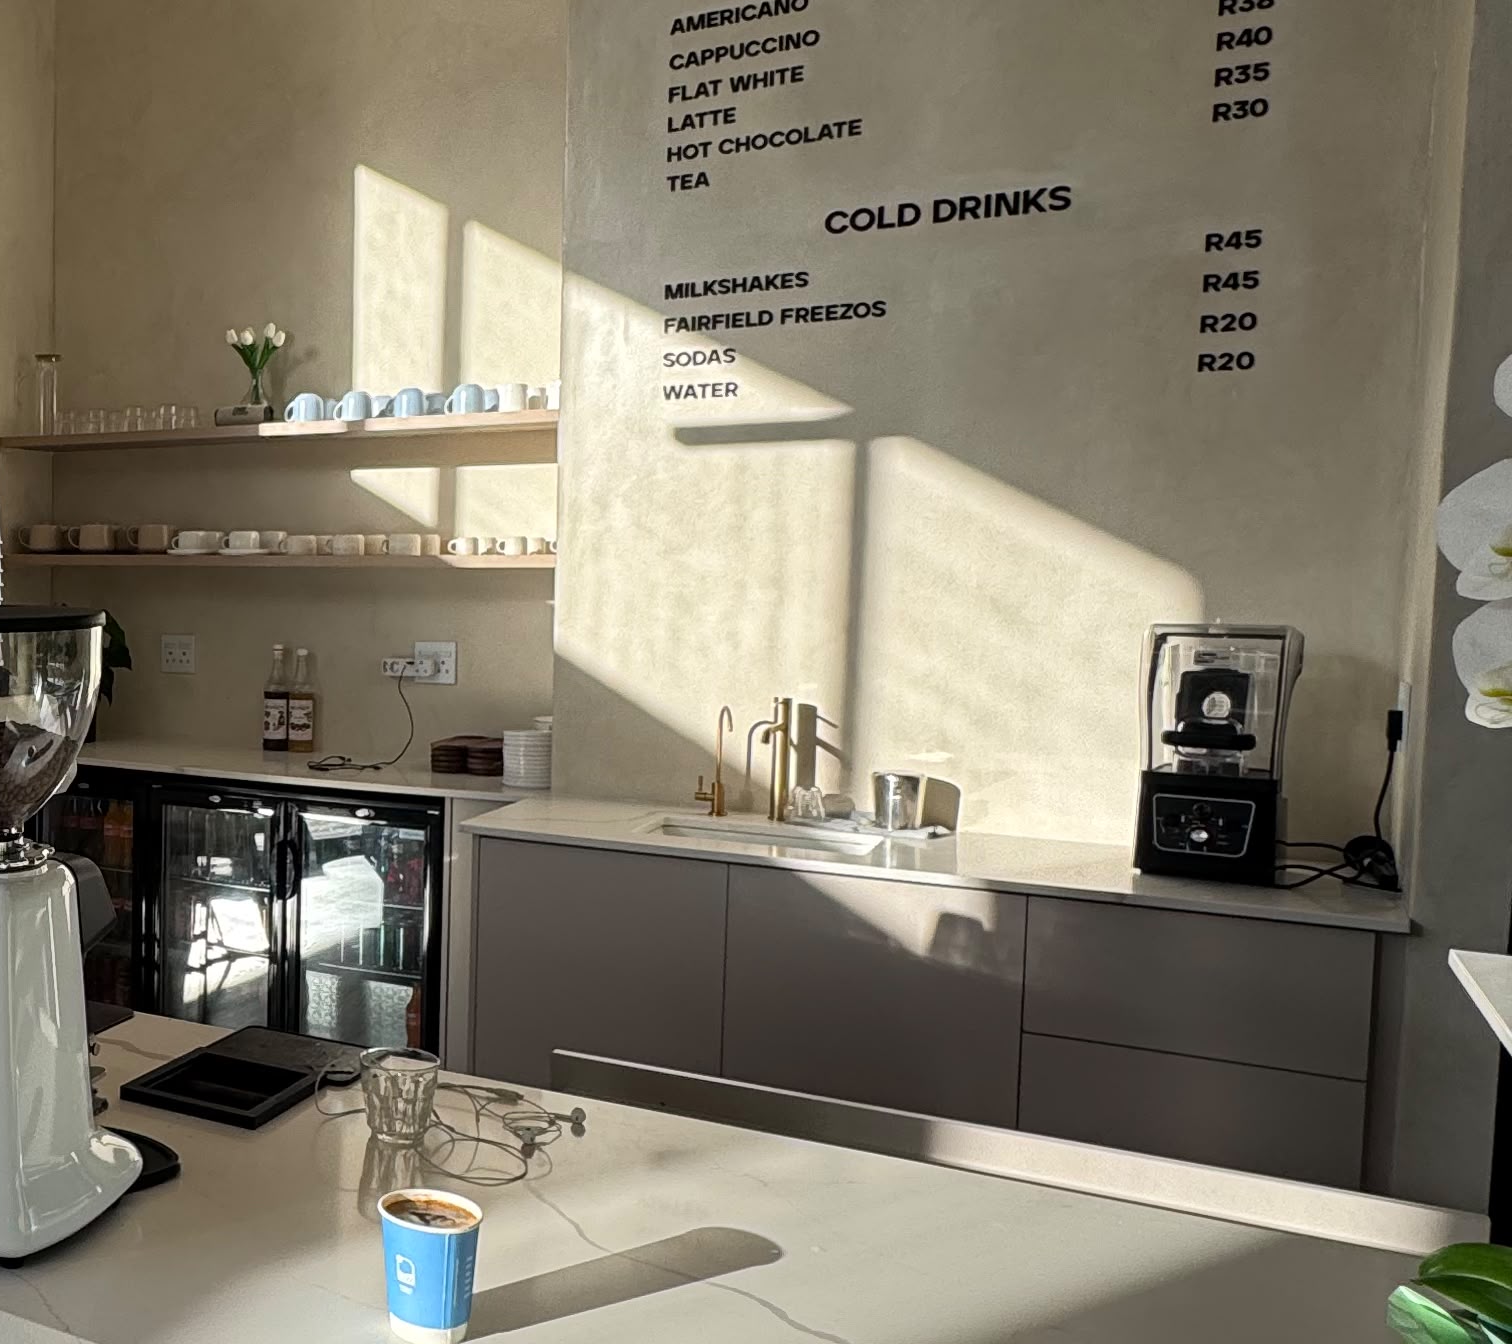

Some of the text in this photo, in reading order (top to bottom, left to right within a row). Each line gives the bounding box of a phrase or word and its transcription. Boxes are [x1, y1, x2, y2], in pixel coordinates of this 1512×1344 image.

[668, 29, 821, 71] CAPPUCCINO
[1215, 25, 1273, 52] R40
[667, 64, 805, 104] FLAT WHITE
[1213, 61, 1271, 88] R35
[667, 107, 737, 134] LATTE
[1211, 97, 1269, 123] R30
[666, 118, 863, 163] HOT CHOCOLATE
[666, 171, 711, 193] TEA
[824, 185, 1072, 235] COLD DRINKS
[1204, 228, 1263, 253] R45
[664, 271, 810, 300] MILKSHAKES
[1202, 270, 1260, 293] R45
[664, 300, 887, 334] FAIRFIELD FREEZOS
[1199, 311, 1258, 334] R20
[662, 347, 737, 368] SODAS
[1197, 351, 1256, 373] R20
[662, 381, 739, 401] WATER
